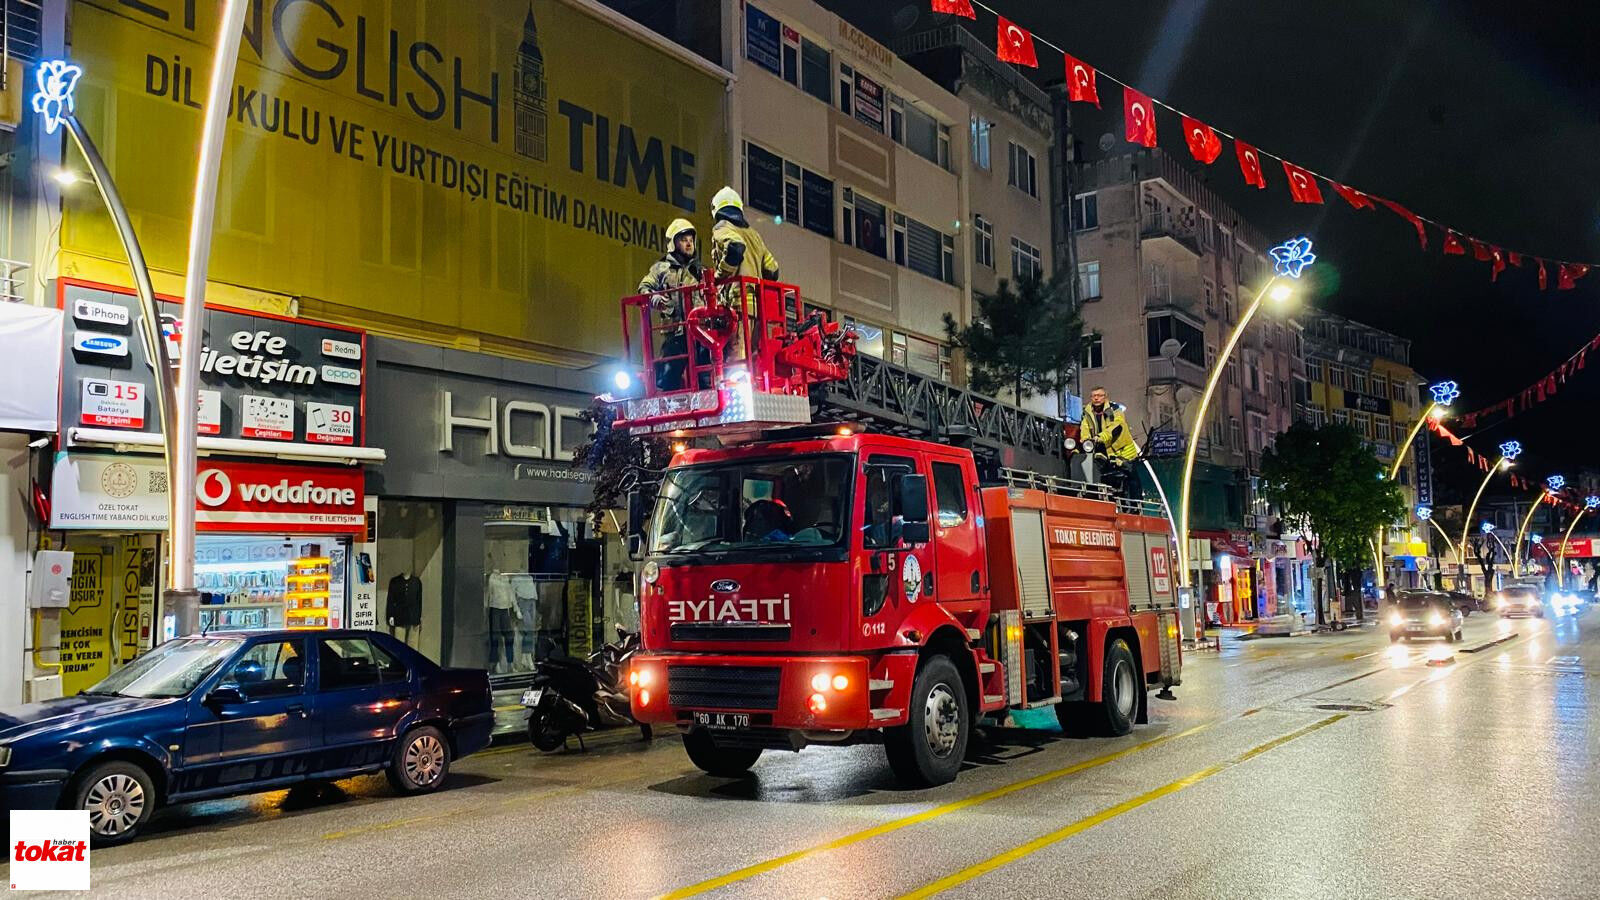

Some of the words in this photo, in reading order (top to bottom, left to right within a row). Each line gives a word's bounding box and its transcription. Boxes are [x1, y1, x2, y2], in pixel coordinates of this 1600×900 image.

[119, 0, 499, 143] GLISH
[558, 99, 695, 213] TIME
[146, 54, 202, 110] DİL
[227, 85, 320, 145] KULU
[329, 115, 365, 161] VE
[371, 130, 488, 202] YURTDIŞI
[495, 171, 567, 224] EĞİTİM
[91, 307, 126, 321] iPhone
[86, 339, 117, 348] SAMSUNG
[231, 330, 287, 355] efe
[335, 344, 356, 355] Redmi
[114, 385, 138, 400] 15
[97, 405, 129, 414] Batarya
[331, 409, 351, 423] 30
[239, 480, 356, 505] vodafone
[98, 503, 116, 511] ÖZEL
[109, 513, 138, 521] YABANCI
[1054, 529, 1077, 544] TOKAT
[1079, 530, 1117, 546] BELEDİYESİ
[1153, 552, 1167, 574] 112
[124, 533, 139, 647] ENGLISH
[871, 622, 885, 634] 112
[73, 640, 91, 652] ÇOK
[59, 653, 73, 662] ER
[76, 650, 103, 661] VEREN
[700, 713, 710, 724] 60
[716, 714, 726, 726] AK
[733, 714, 749, 727] 170
